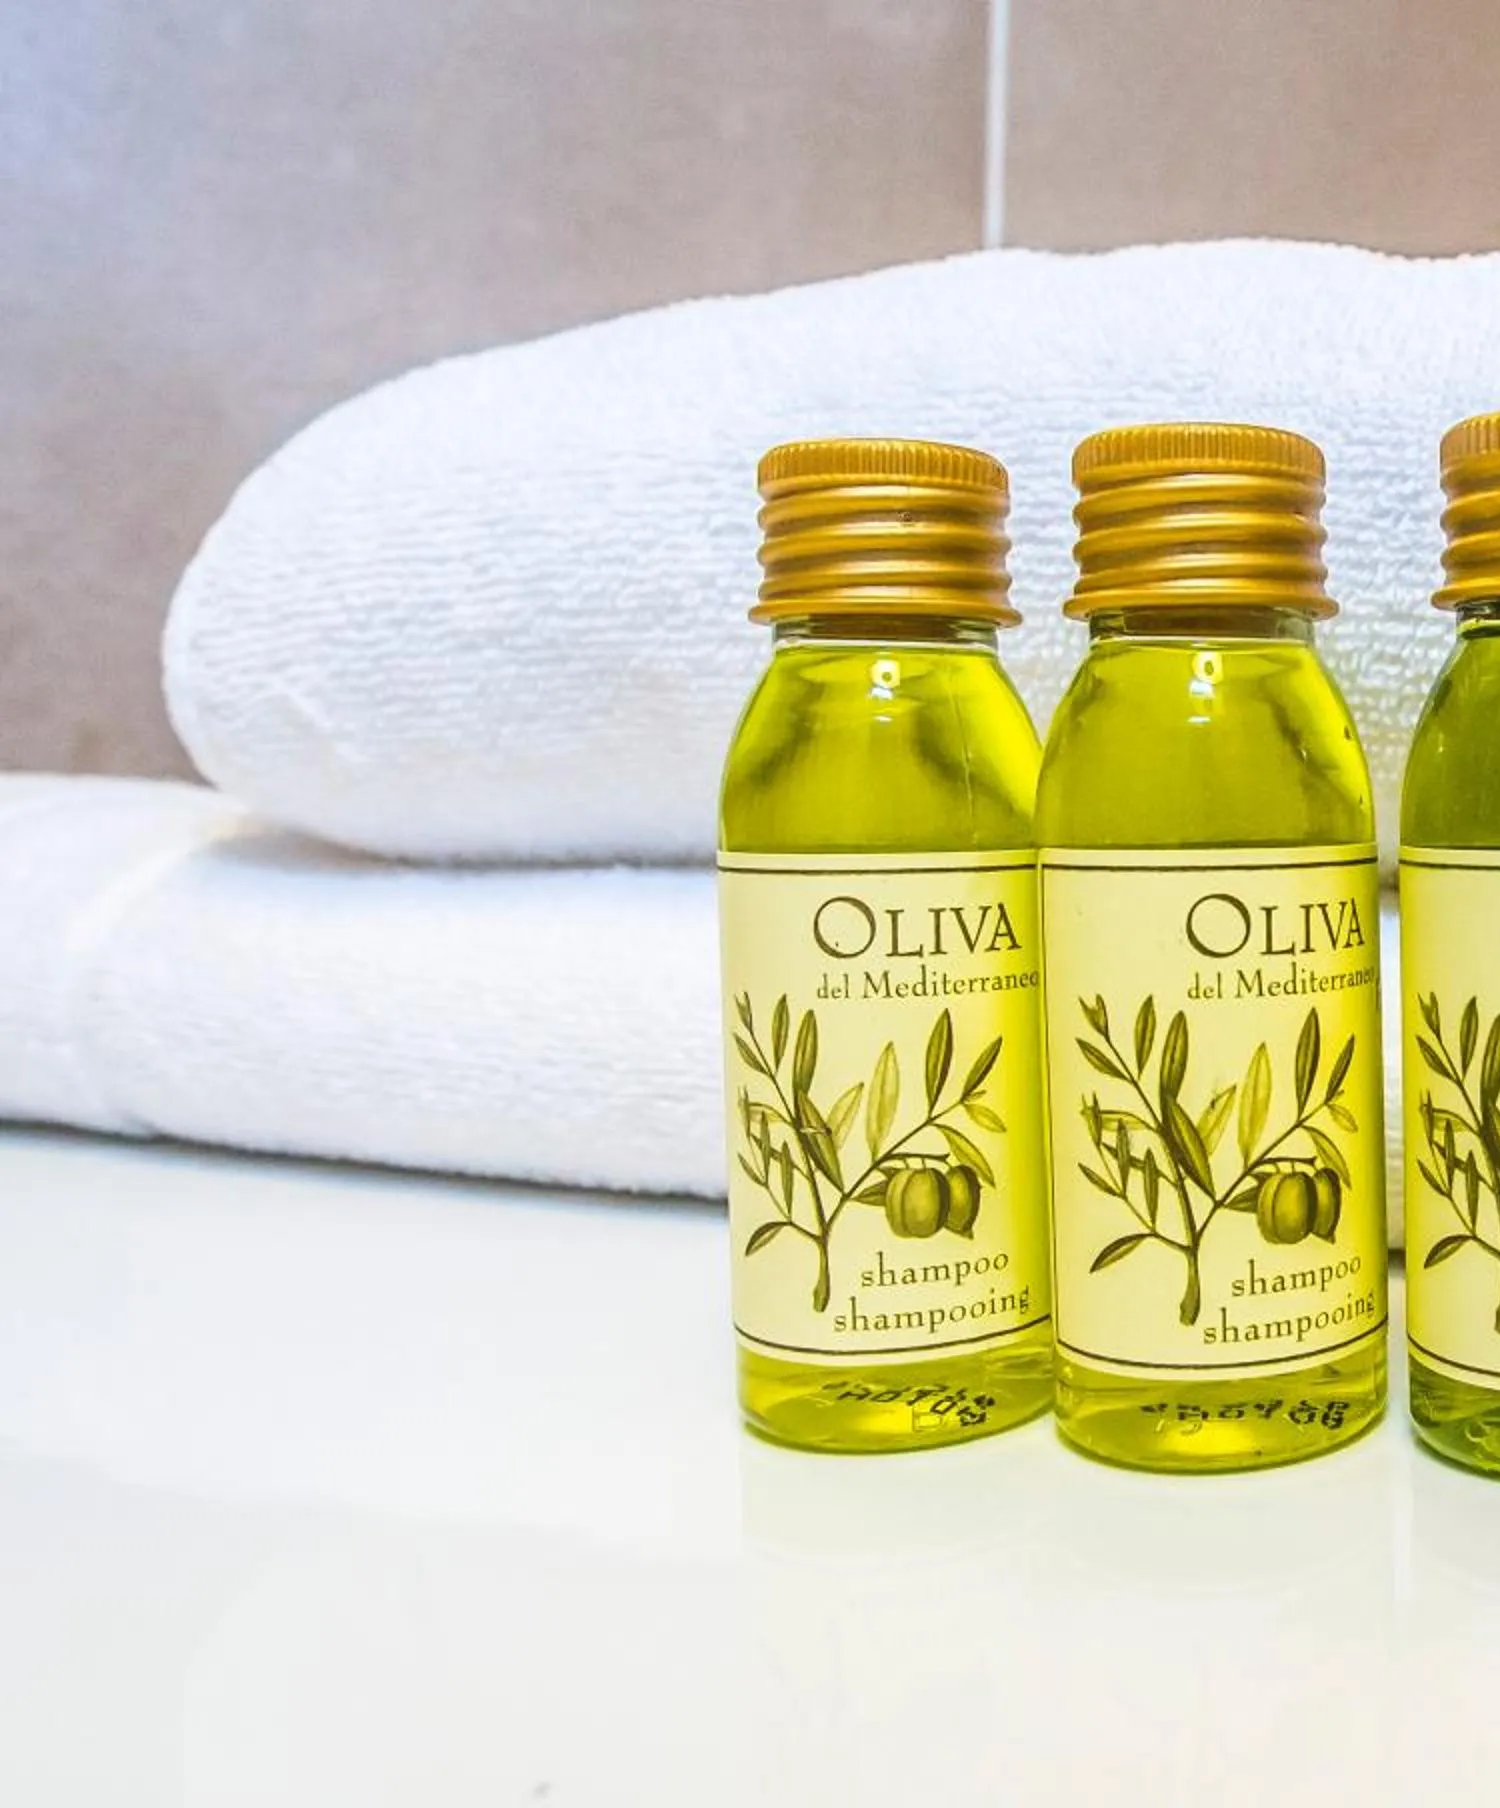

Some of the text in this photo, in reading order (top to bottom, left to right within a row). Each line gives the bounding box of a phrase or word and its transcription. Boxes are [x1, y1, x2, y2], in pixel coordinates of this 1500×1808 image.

[813, 895, 1023, 959] OLIVA
[1185, 893, 1366, 959] OLIVA
[816, 963, 1041, 1000] del Mediterraneo
[1187, 971, 1223, 1000] del
[860, 1250, 1009, 1288] shampoo
[1231, 1256, 1362, 1298] shampoo
[834, 1284, 1030, 1335] shampooing
[1203, 1290, 1375, 1345] shampooing
